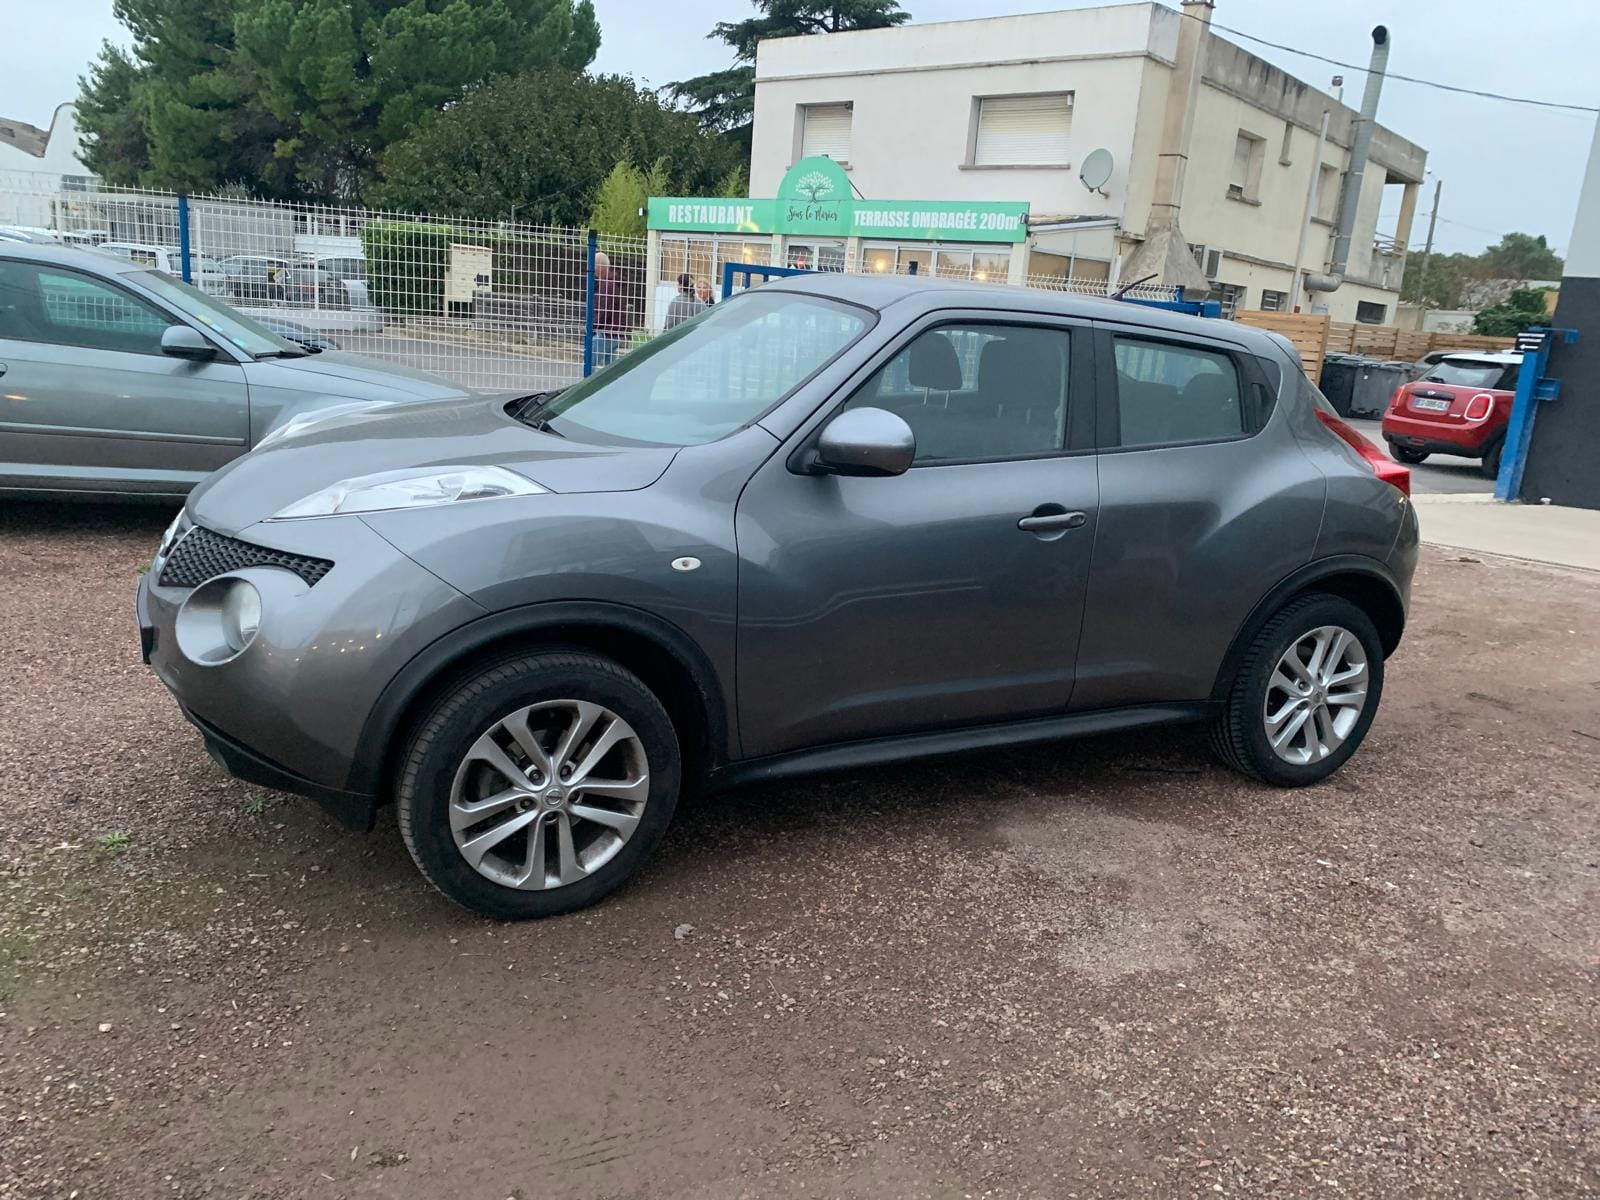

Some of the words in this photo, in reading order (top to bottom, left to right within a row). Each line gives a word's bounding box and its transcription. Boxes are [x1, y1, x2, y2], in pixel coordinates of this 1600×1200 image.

[668, 204, 754, 225] RESTAURANT
[787, 206, 803, 222] Sous
[854, 210, 910, 228] TERRASSE
[912, 209, 977, 230] OMBRAGÉE
